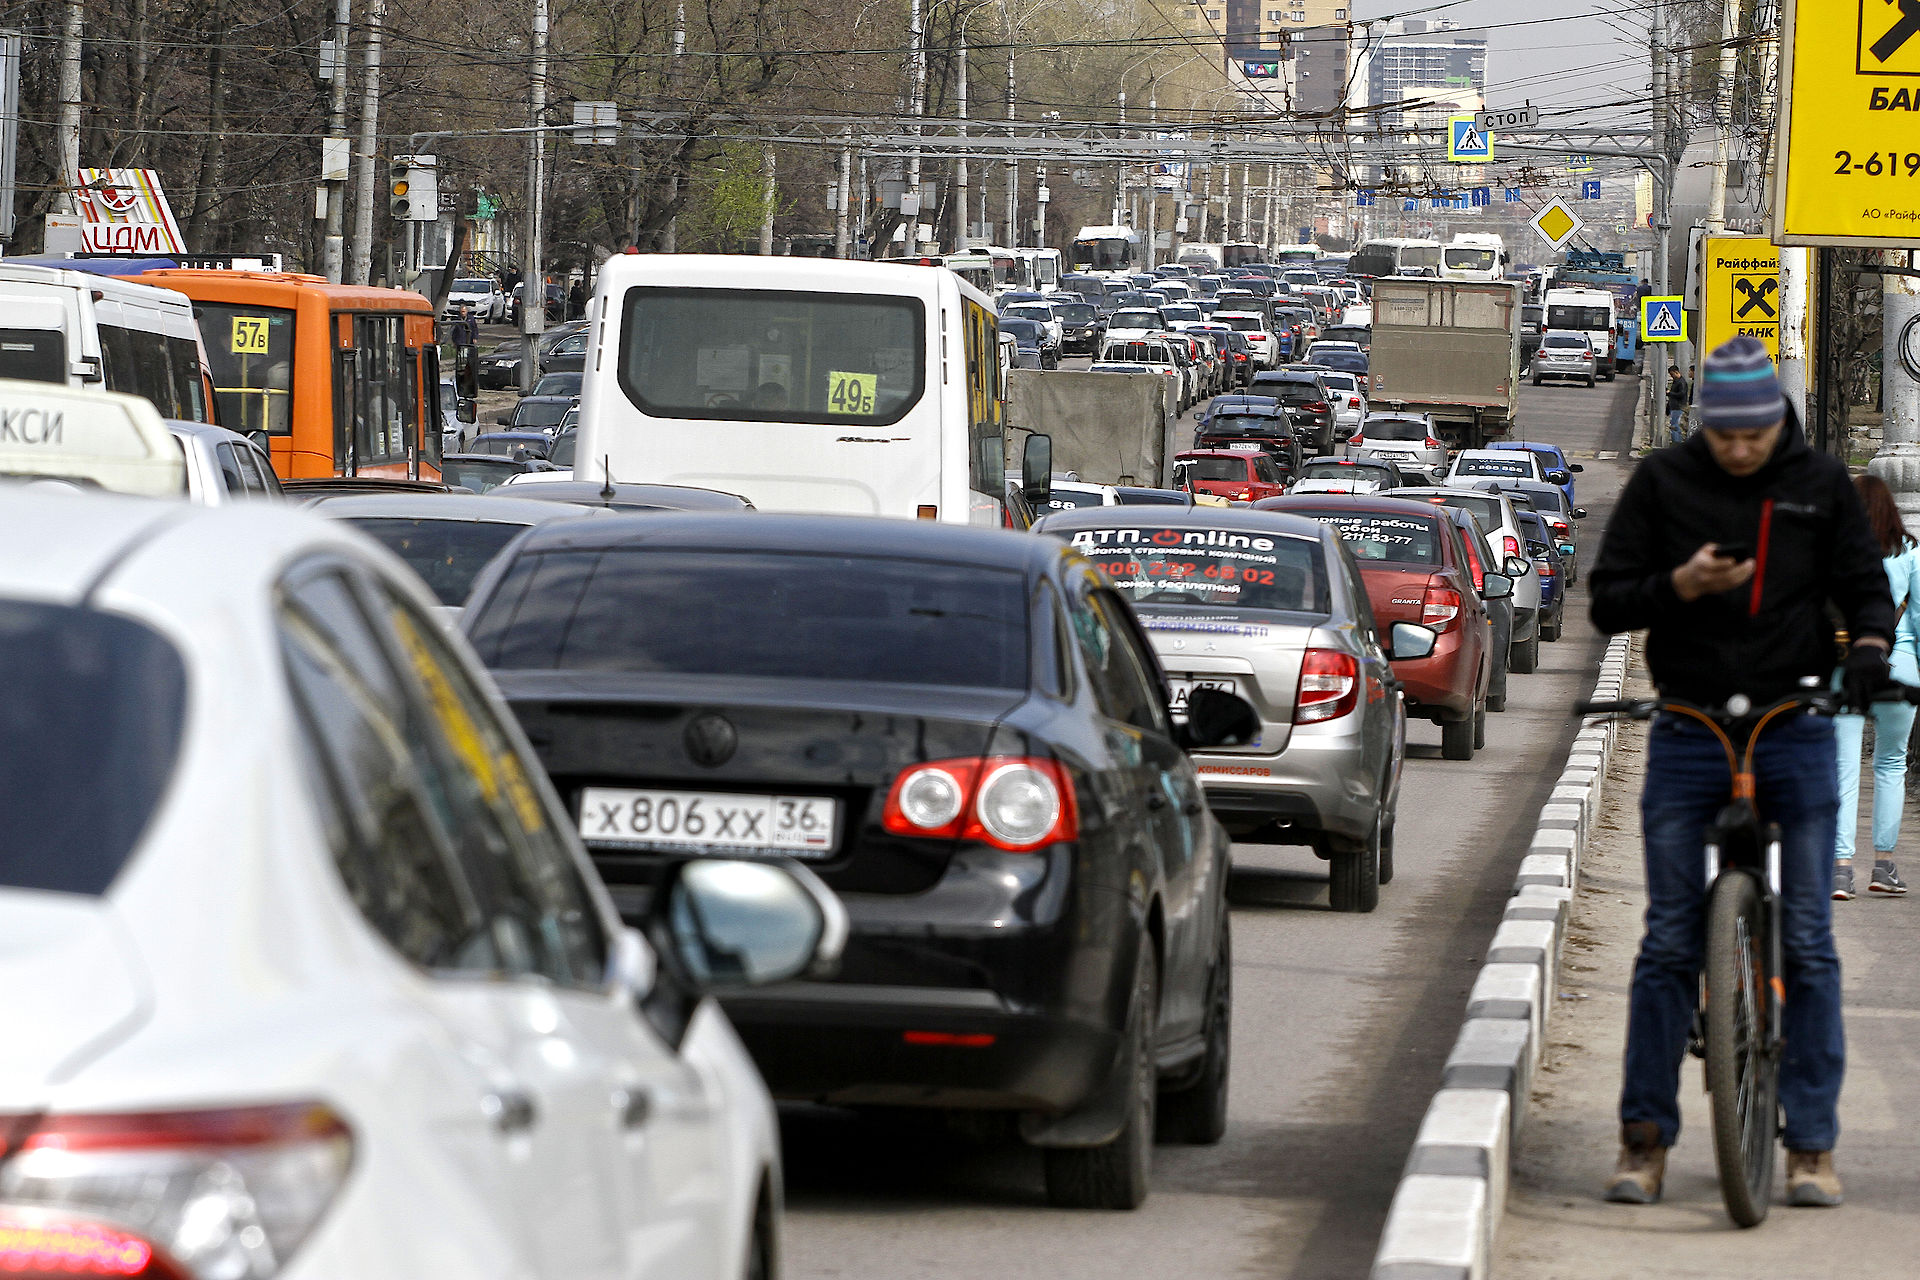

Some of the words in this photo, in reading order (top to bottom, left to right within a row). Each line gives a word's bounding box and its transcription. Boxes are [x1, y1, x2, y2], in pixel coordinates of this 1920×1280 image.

[1485, 111, 1529, 128] СТОП
[1862, 208, 1881, 219] АО
[93, 226, 159, 254] ЦДМ
[1737, 327, 1775, 338] БАНК
[1340, 524, 1381, 534] обои
[1370, 519, 1430, 532] работы
[1342, 532, 1413, 545] 211-53-77
[1135, 547, 1206, 558] страховых
[1208, 549, 1278, 564] компаний
[1148, 562, 1197, 577] 222
[1203, 565, 1236, 580] 68
[1242, 568, 1276, 586] 02
[1157, 578, 1242, 594] бесплатный
[1391, 598, 1421, 606] GRANTA
[1149, 621, 1241, 635] ОФОРМЛЕНИЕ
[1242, 625, 1269, 637] ДТП
[1197, 765, 1272, 777] КОМИССАРОВ
[778, 801, 818, 831] 36
